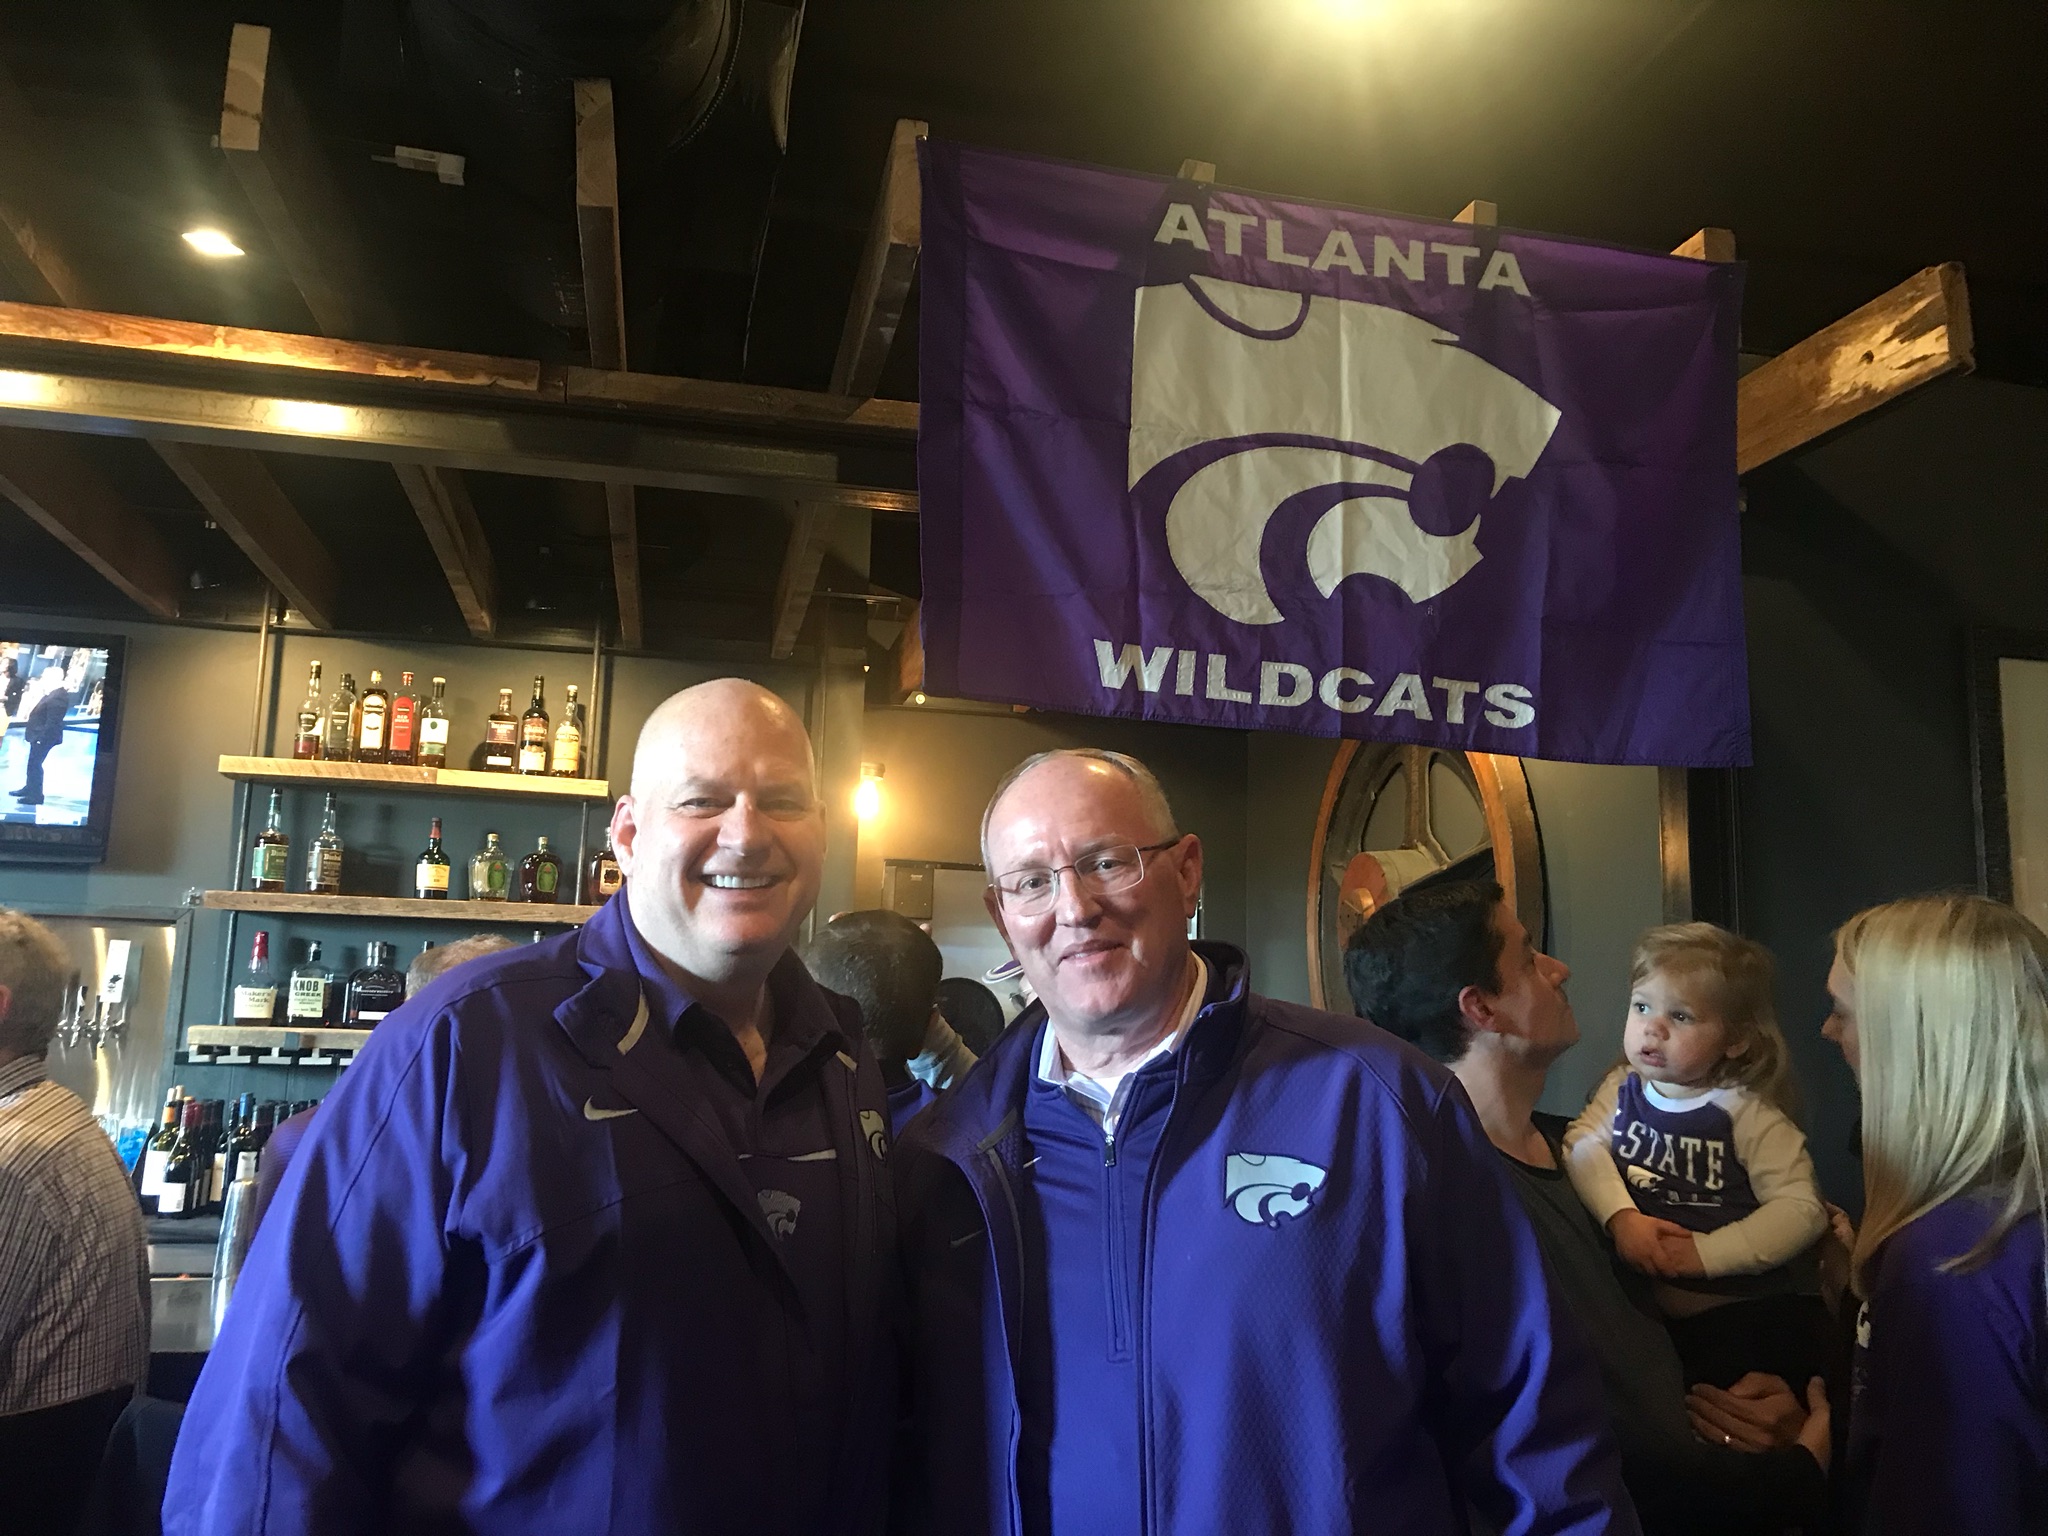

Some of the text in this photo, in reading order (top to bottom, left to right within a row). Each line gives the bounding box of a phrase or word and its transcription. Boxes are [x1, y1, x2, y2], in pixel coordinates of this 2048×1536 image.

[1153, 202, 1532, 297] ATLANTA
[1093, 638, 1536, 729] WILDCATS
[293, 980, 319, 991] KNOB
[1619, 1121, 1724, 1191] STATE
